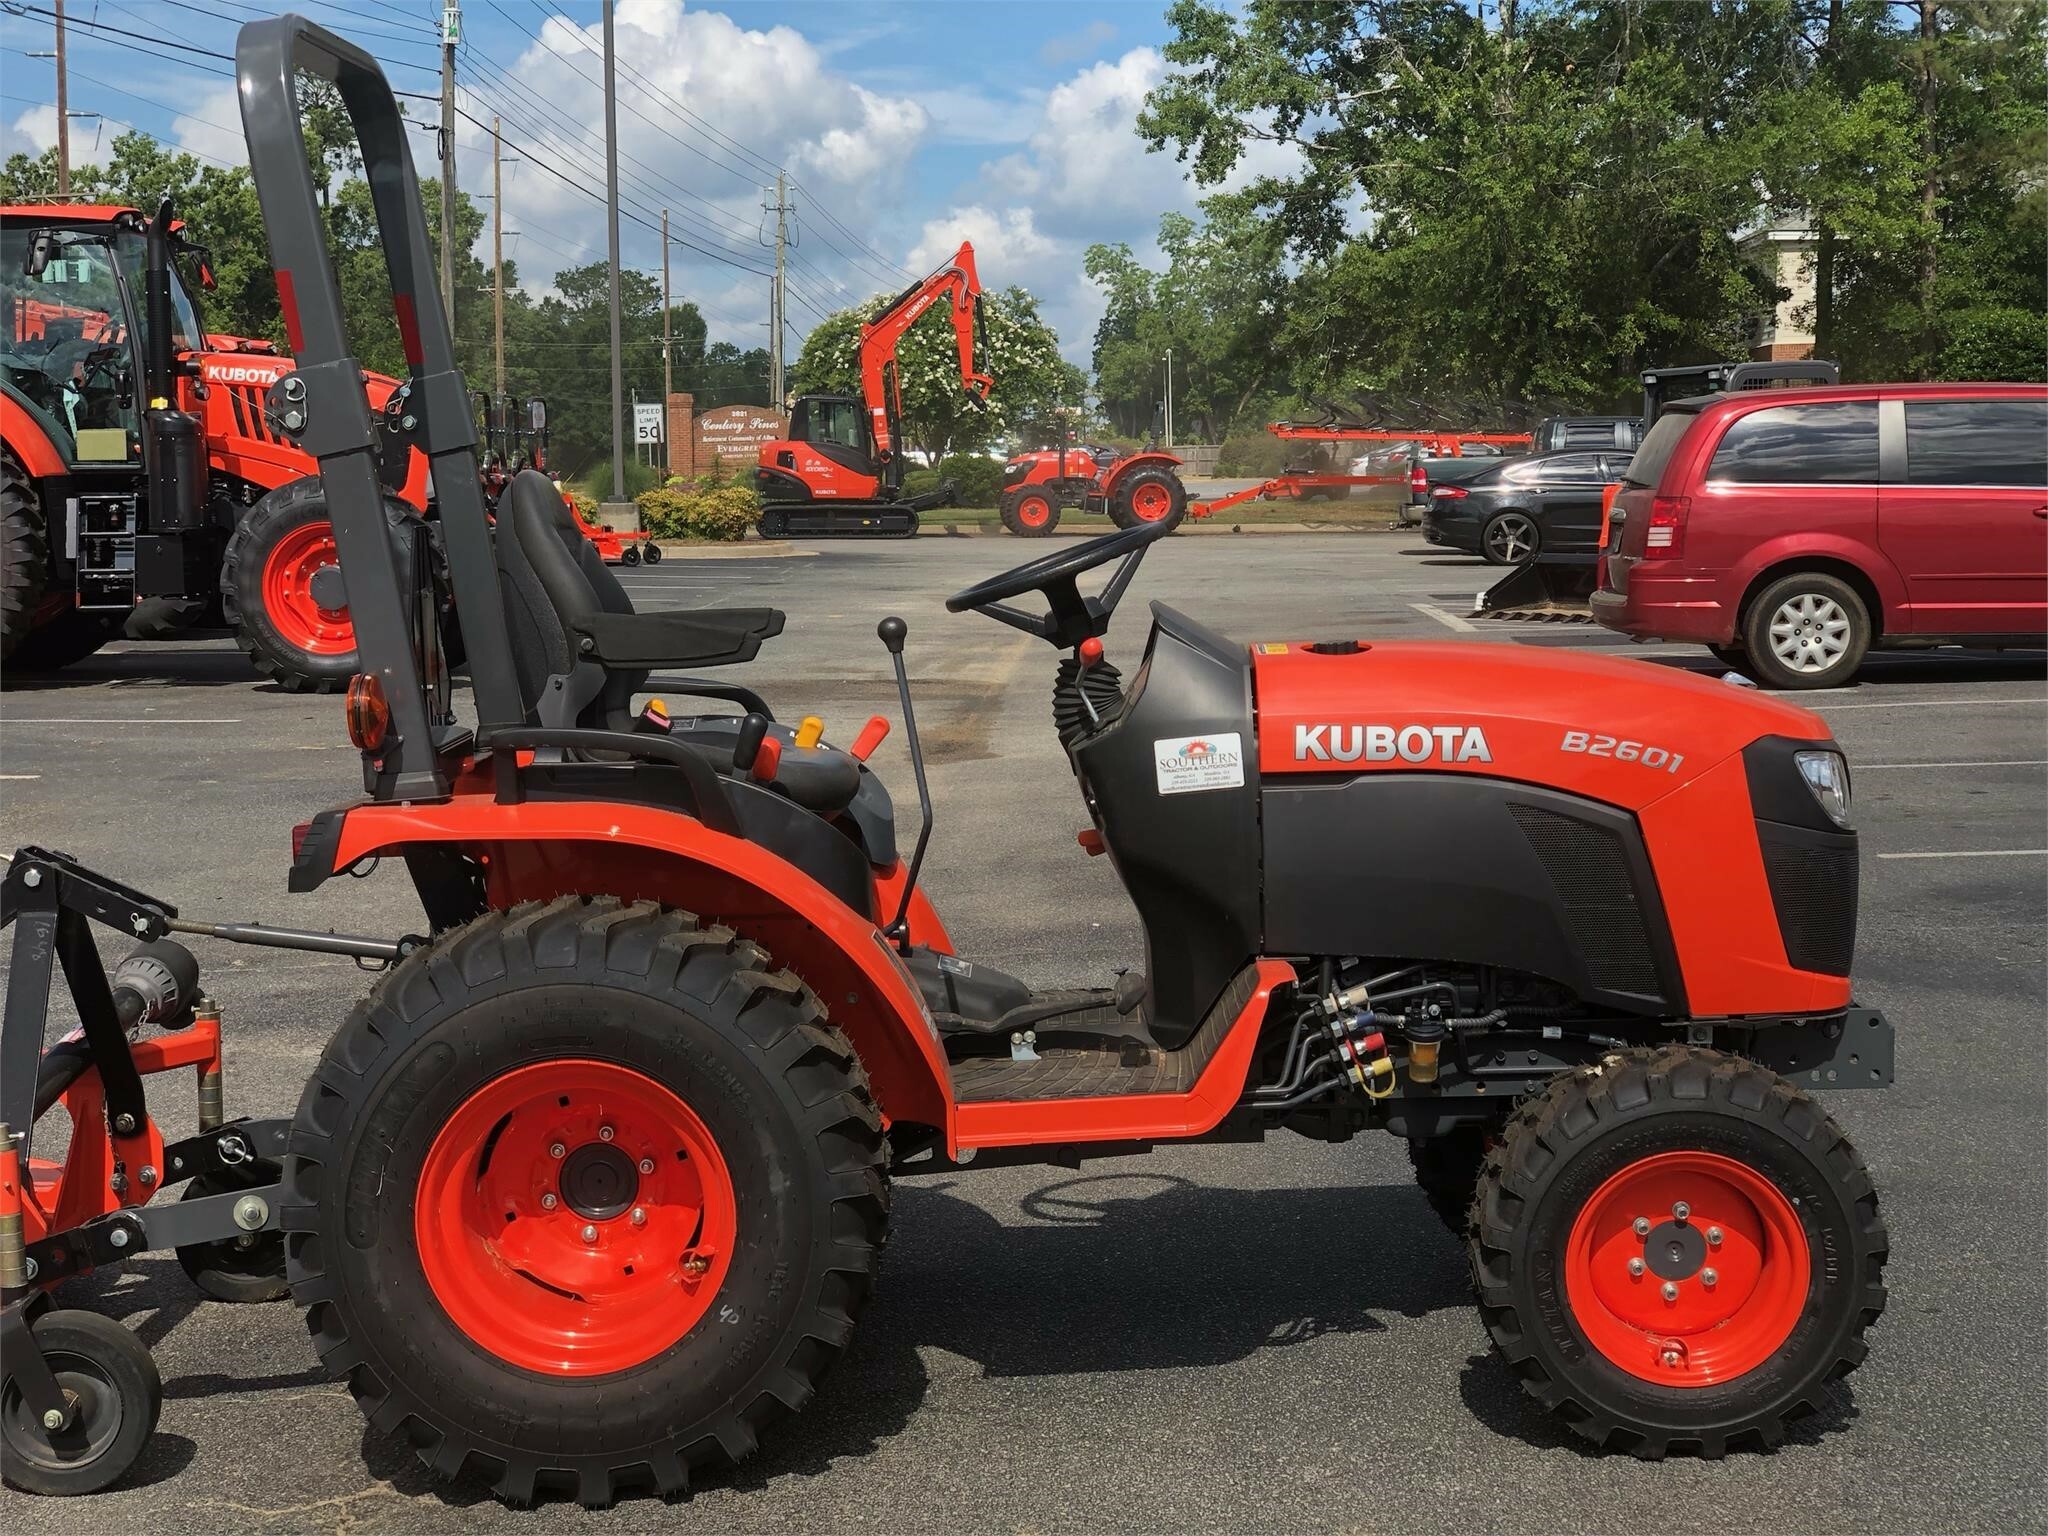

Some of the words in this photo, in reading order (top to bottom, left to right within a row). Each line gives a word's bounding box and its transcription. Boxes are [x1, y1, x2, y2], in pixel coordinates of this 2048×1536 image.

[904, 294, 930, 320] KUBOTA
[208, 366, 279, 384] KUBOTA
[639, 426, 659, 439] 50
[701, 418, 745, 434] Century
[749, 417, 780, 430] Pines
[1294, 725, 1493, 763] KUBOTA
[1561, 731, 1684, 774] B2601
[1160, 752, 1238, 769] SOUTHERN
[1163, 766, 1193, 774] TRACTOR
[1200, 762, 1238, 770] OUTDOORS
